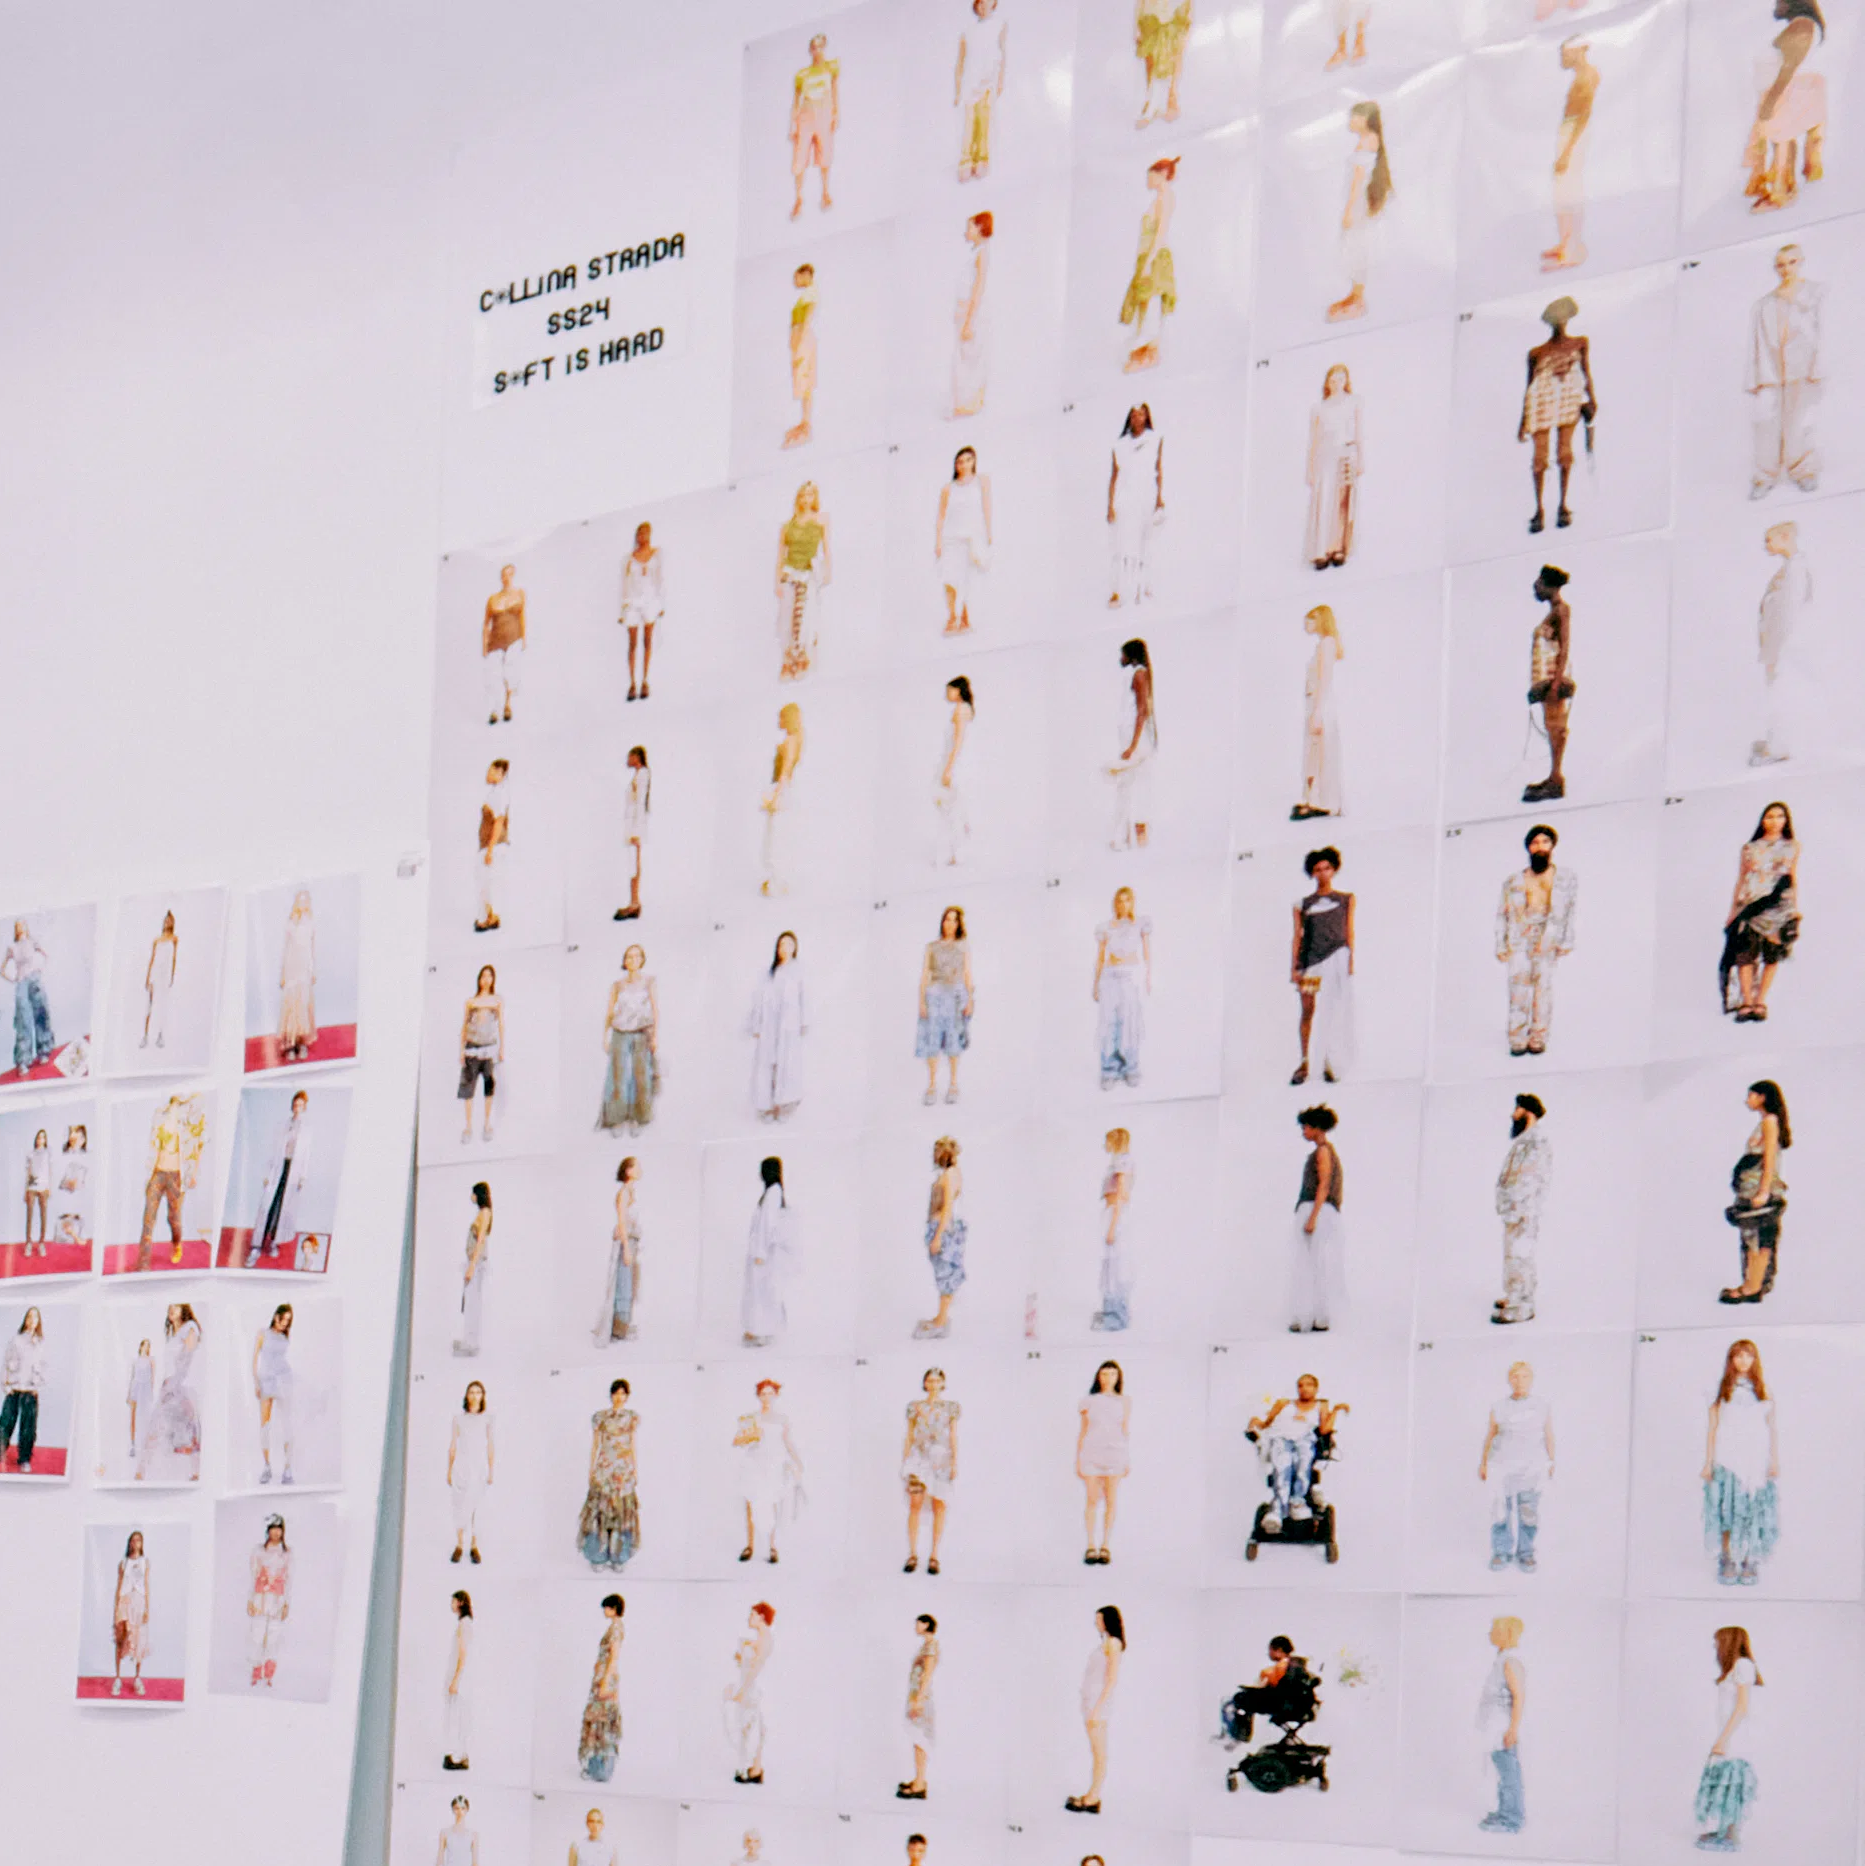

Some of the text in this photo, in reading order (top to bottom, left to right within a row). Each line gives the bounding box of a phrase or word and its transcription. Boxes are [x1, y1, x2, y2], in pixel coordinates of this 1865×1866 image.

[587, 232, 686, 281] STRADA
[547, 297, 611, 335] SS24
[565, 349, 589, 376] IS
[598, 327, 664, 366] HARD
